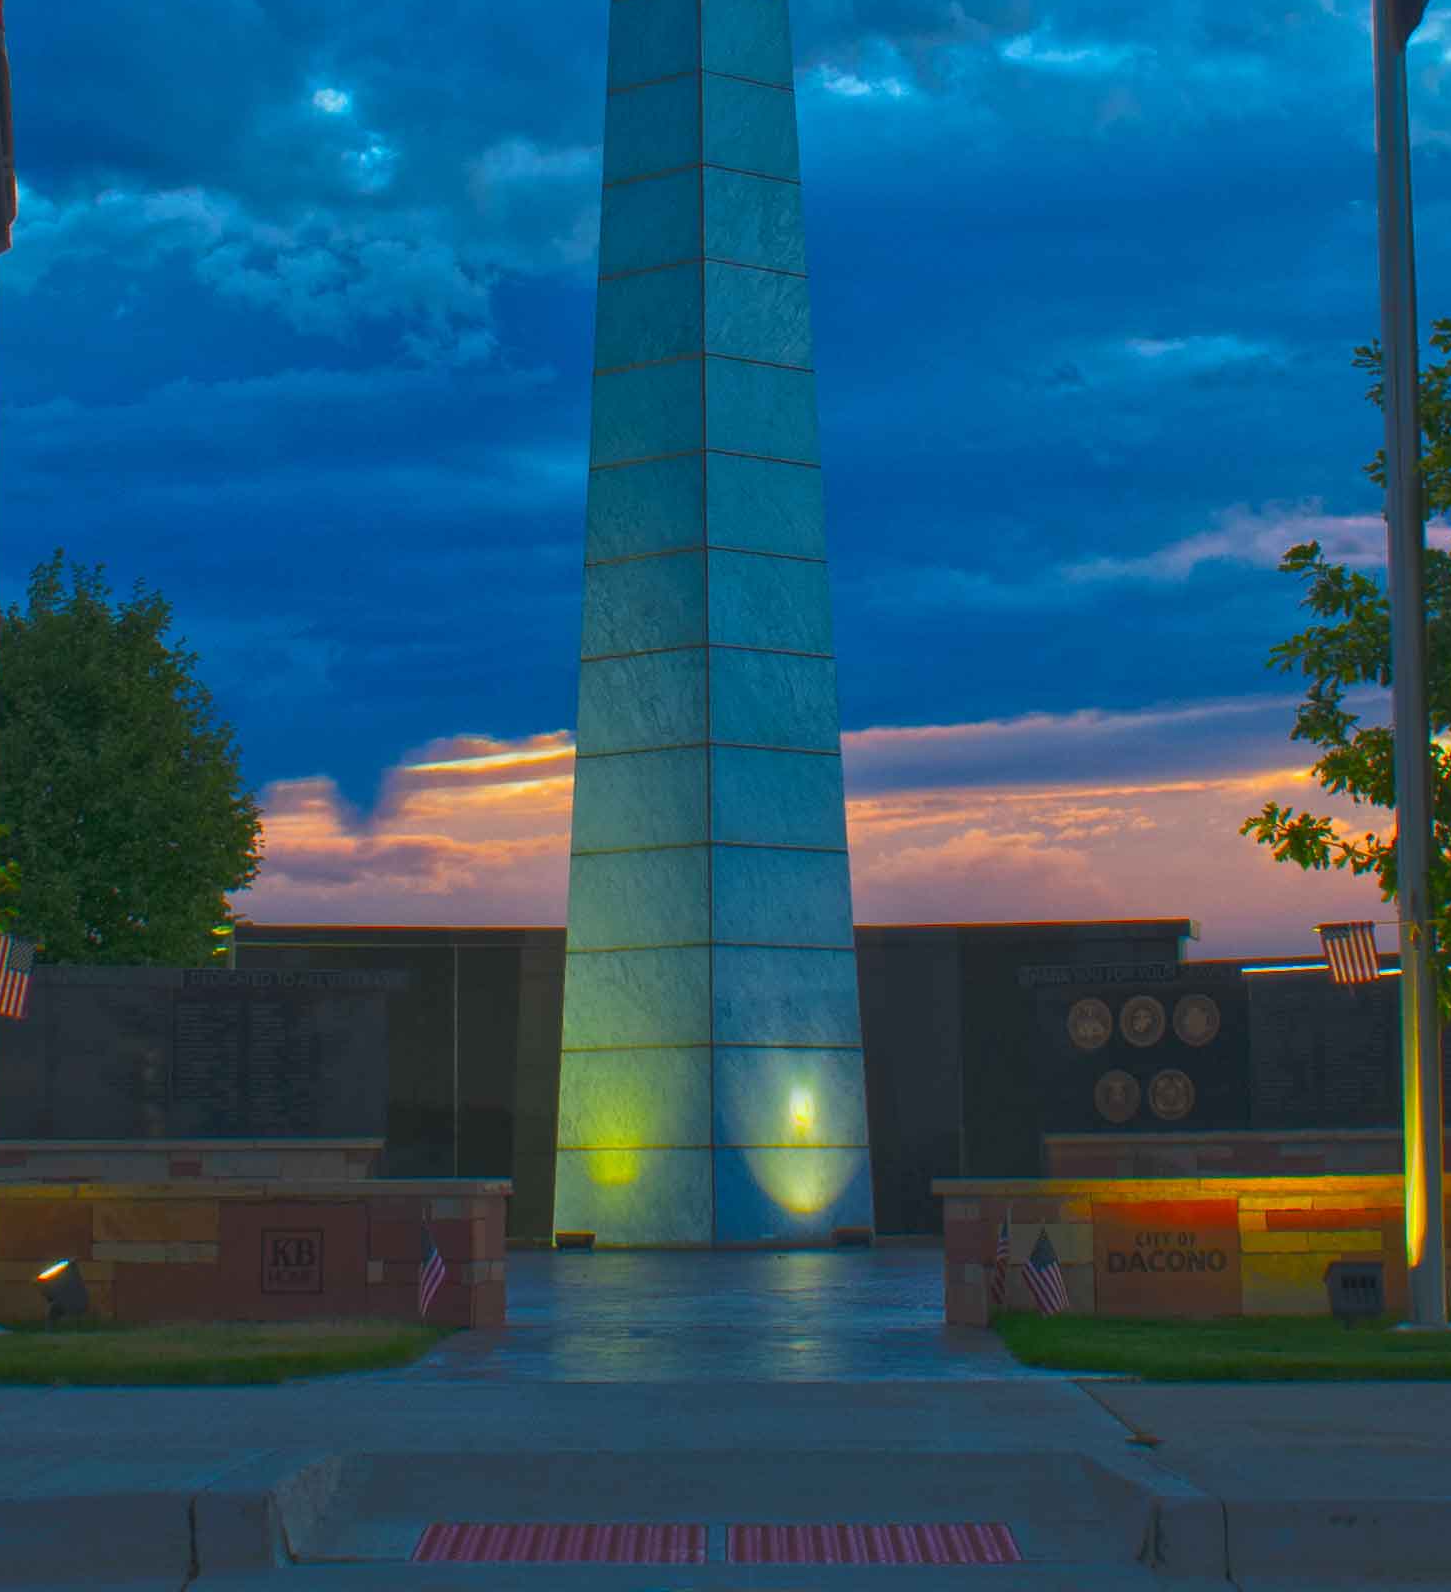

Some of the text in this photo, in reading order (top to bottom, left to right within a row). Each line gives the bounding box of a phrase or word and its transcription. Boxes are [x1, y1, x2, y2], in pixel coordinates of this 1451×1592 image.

[1135, 1232, 1196, 1247] CITY OF
[271, 1239, 316, 1266] KB
[1108, 1249, 1227, 1273] DACONO
